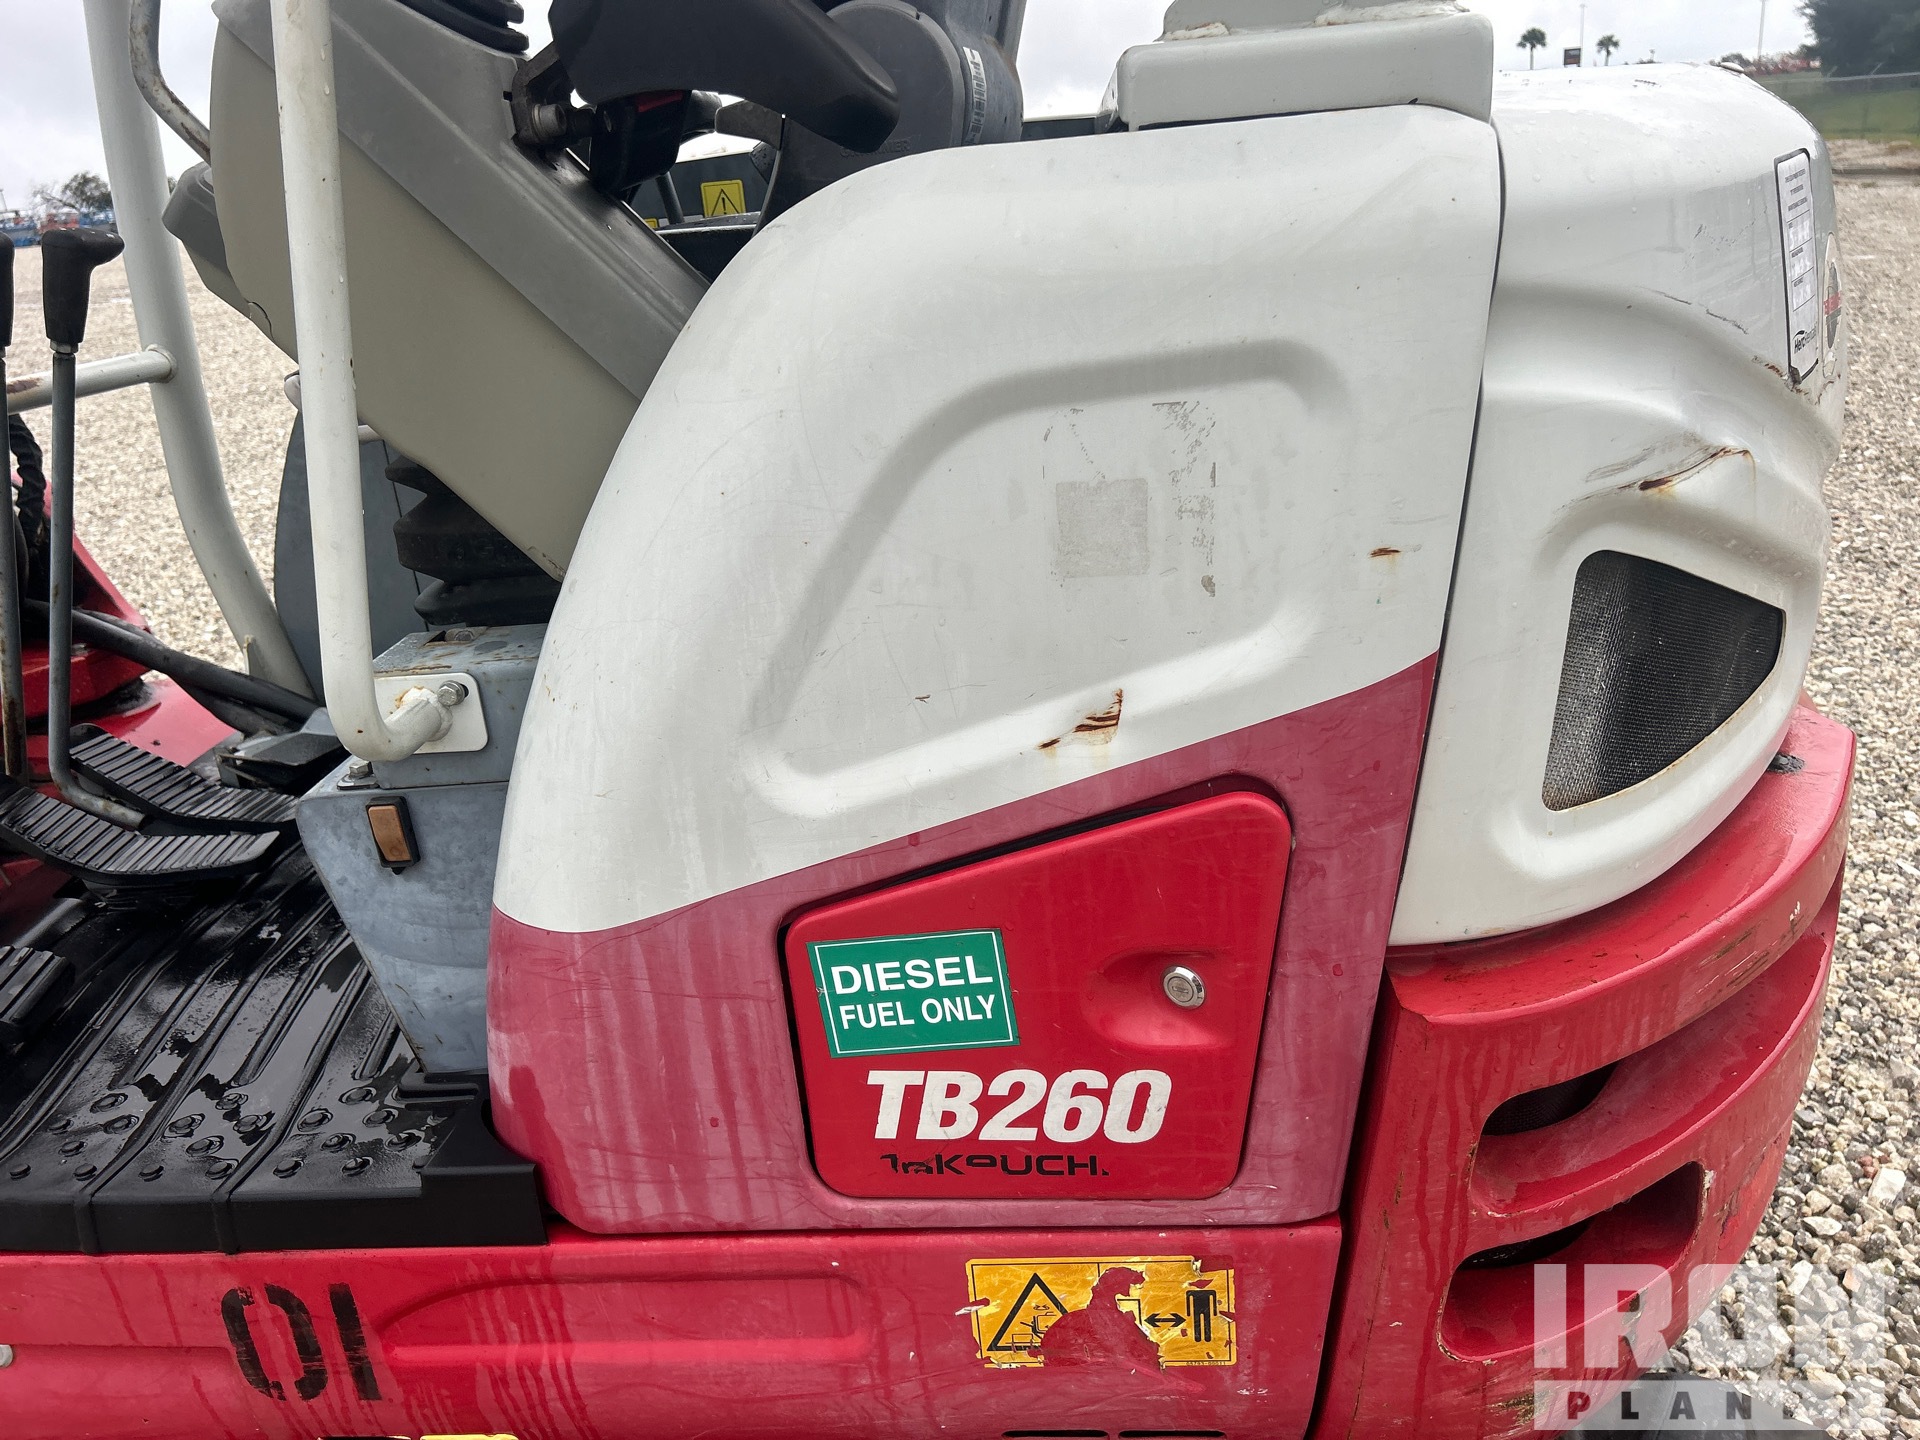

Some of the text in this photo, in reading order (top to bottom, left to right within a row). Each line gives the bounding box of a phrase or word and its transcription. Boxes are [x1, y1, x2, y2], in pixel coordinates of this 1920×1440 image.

[831, 955, 993, 995] DIESEL
[839, 994, 996, 1030] FUEL ONLY
[866, 1069, 1172, 1144] TB260
[221, 1282, 382, 1401] 01
